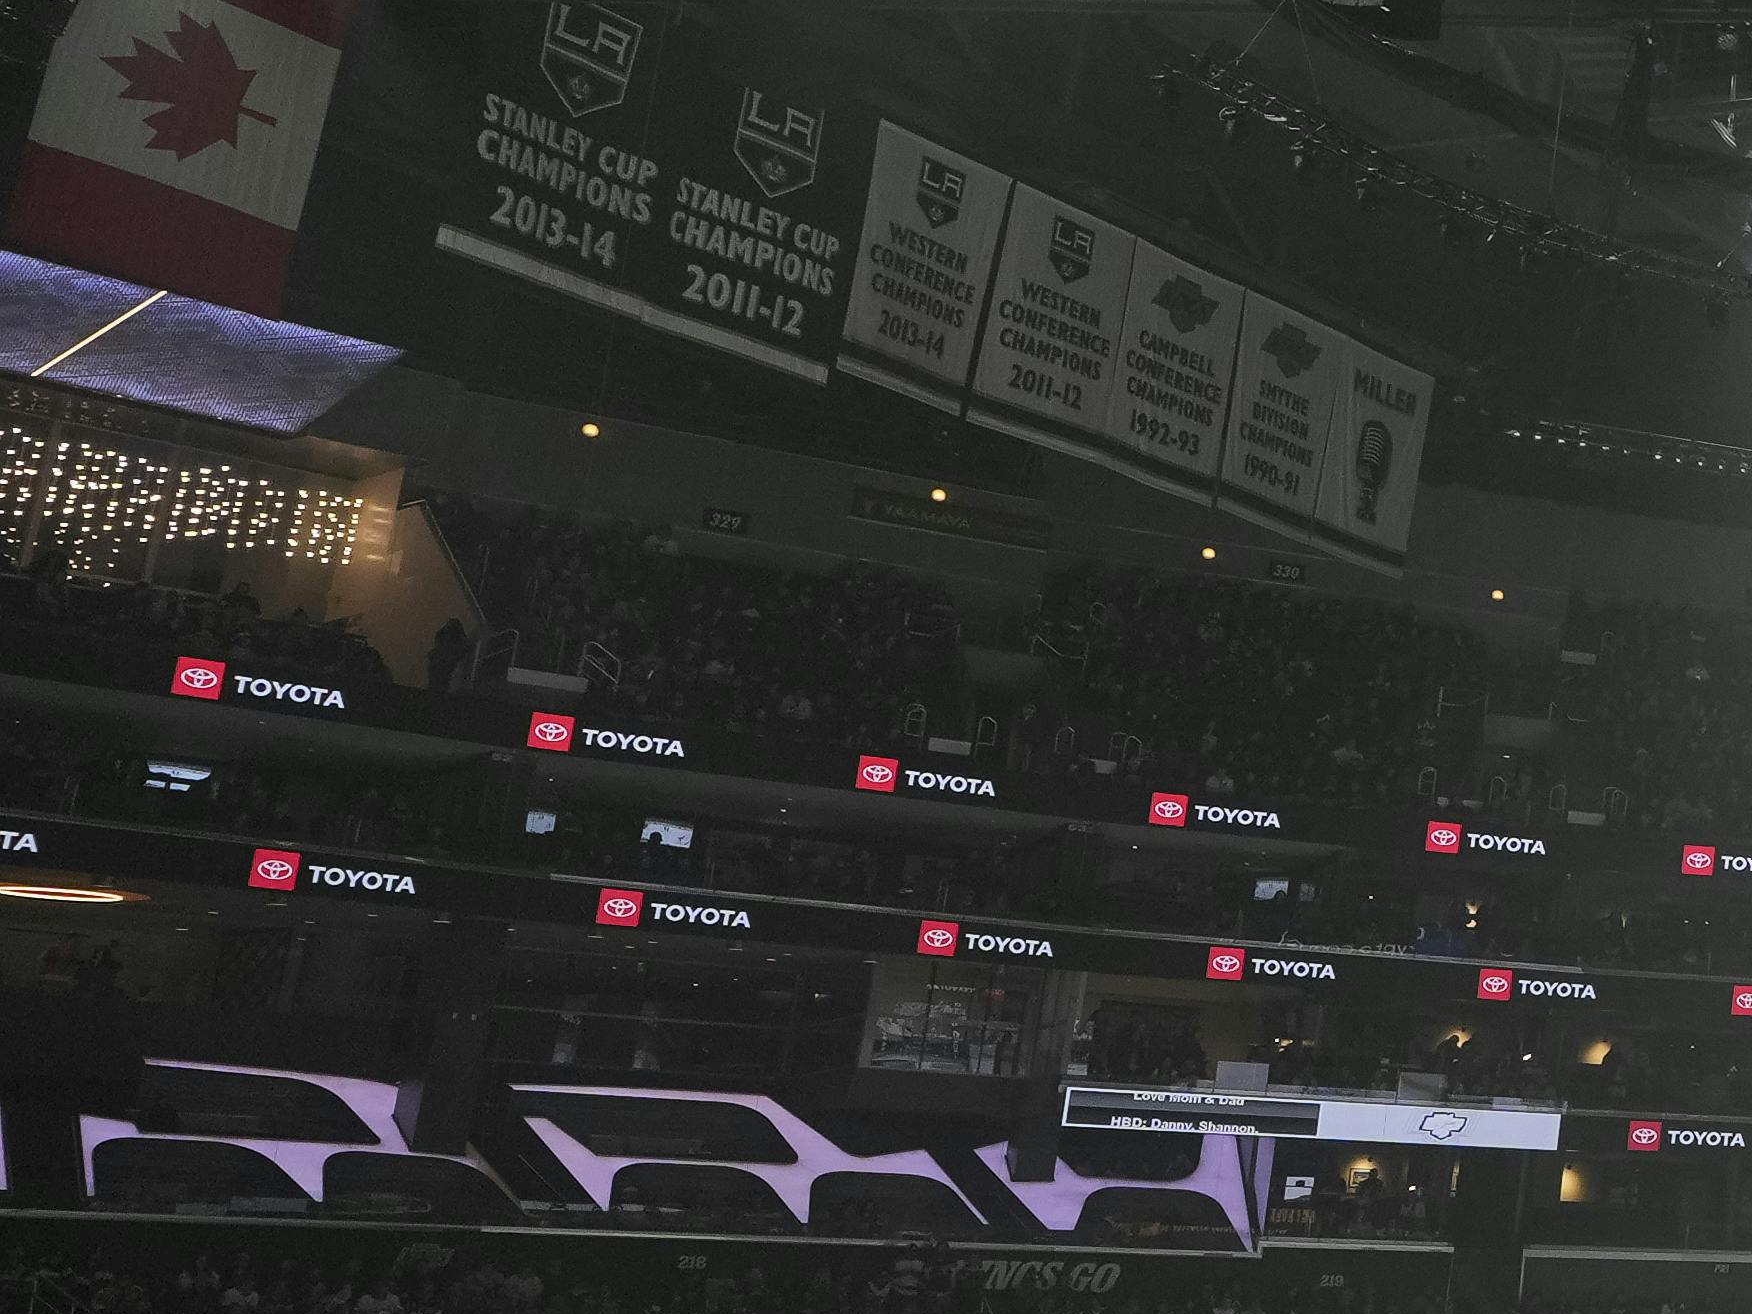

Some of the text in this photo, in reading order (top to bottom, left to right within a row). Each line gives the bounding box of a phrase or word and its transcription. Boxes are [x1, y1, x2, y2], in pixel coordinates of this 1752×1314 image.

[483, 93, 659, 185] STANLEY CUP
[477, 129, 652, 224] CHAMPIONS
[490, 185, 616, 268] 2013-14
[677, 177, 840, 261] STANLEY CUP
[670, 210, 835, 295] CHAMPIONS
[682, 264, 804, 335] 2011-12
[1139, 330, 1215, 378] CAMPBELL
[1354, 368, 1416, 416] MILLER
[235, 676, 344, 708] TOYOTA
[583, 729, 684, 757] TOYOTA
[1195, 805, 1280, 828] TOYOTA
[1467, 834, 1545, 855] TOYOTA
[651, 903, 750, 928] TOYOTA
[966, 934, 1052, 957] TOYOTA
[1519, 980, 1596, 999] TOYOTA
